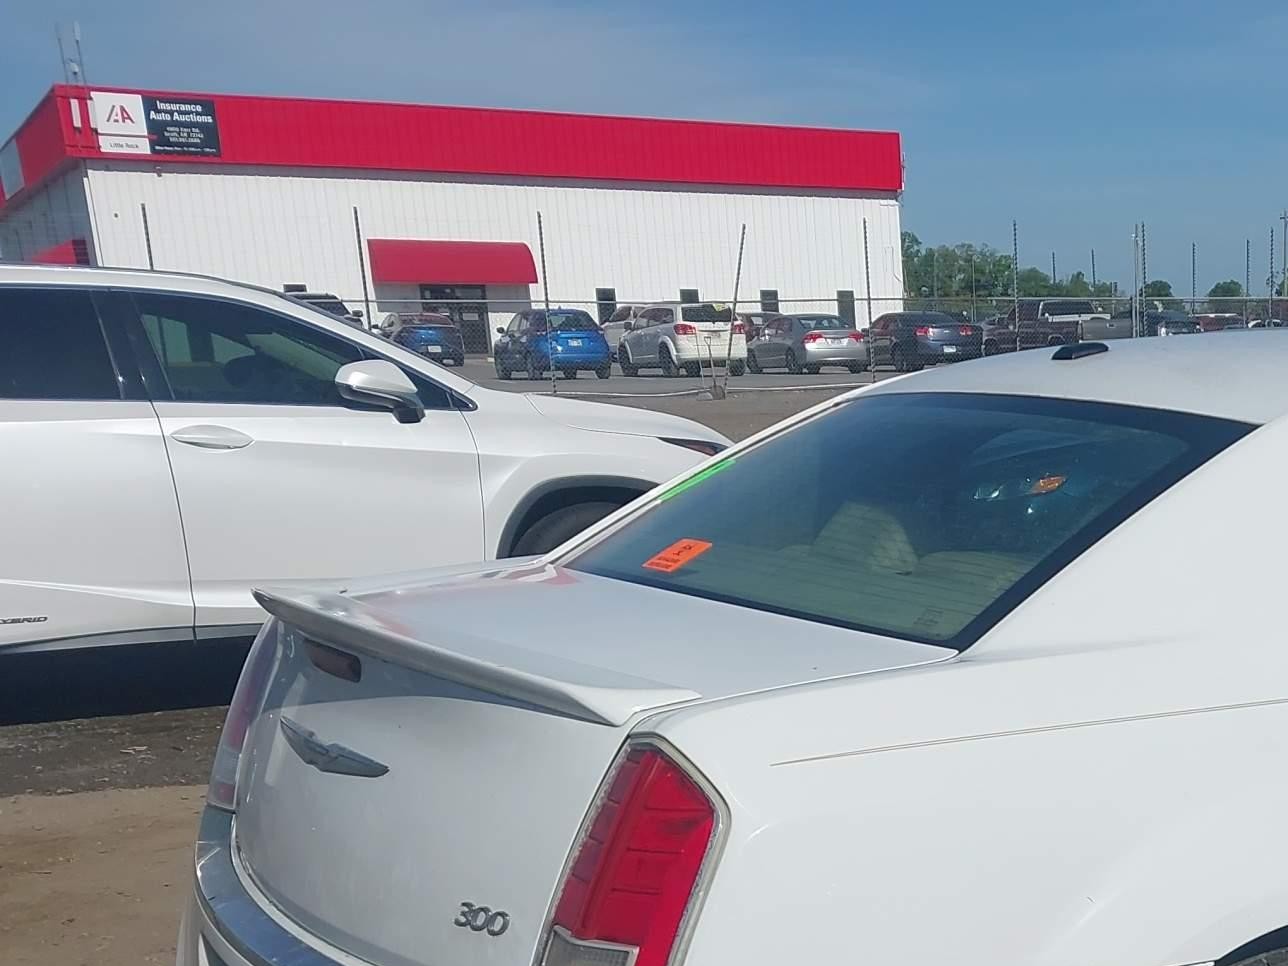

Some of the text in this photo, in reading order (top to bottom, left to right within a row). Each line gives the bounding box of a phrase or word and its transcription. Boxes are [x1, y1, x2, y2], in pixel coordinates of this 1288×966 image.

[157, 100, 202, 111] Insurance
[150, 111, 213, 122] Auto Auctions
[0, 616, 48, 625] YBRID
[454, 902, 511, 937] 300
